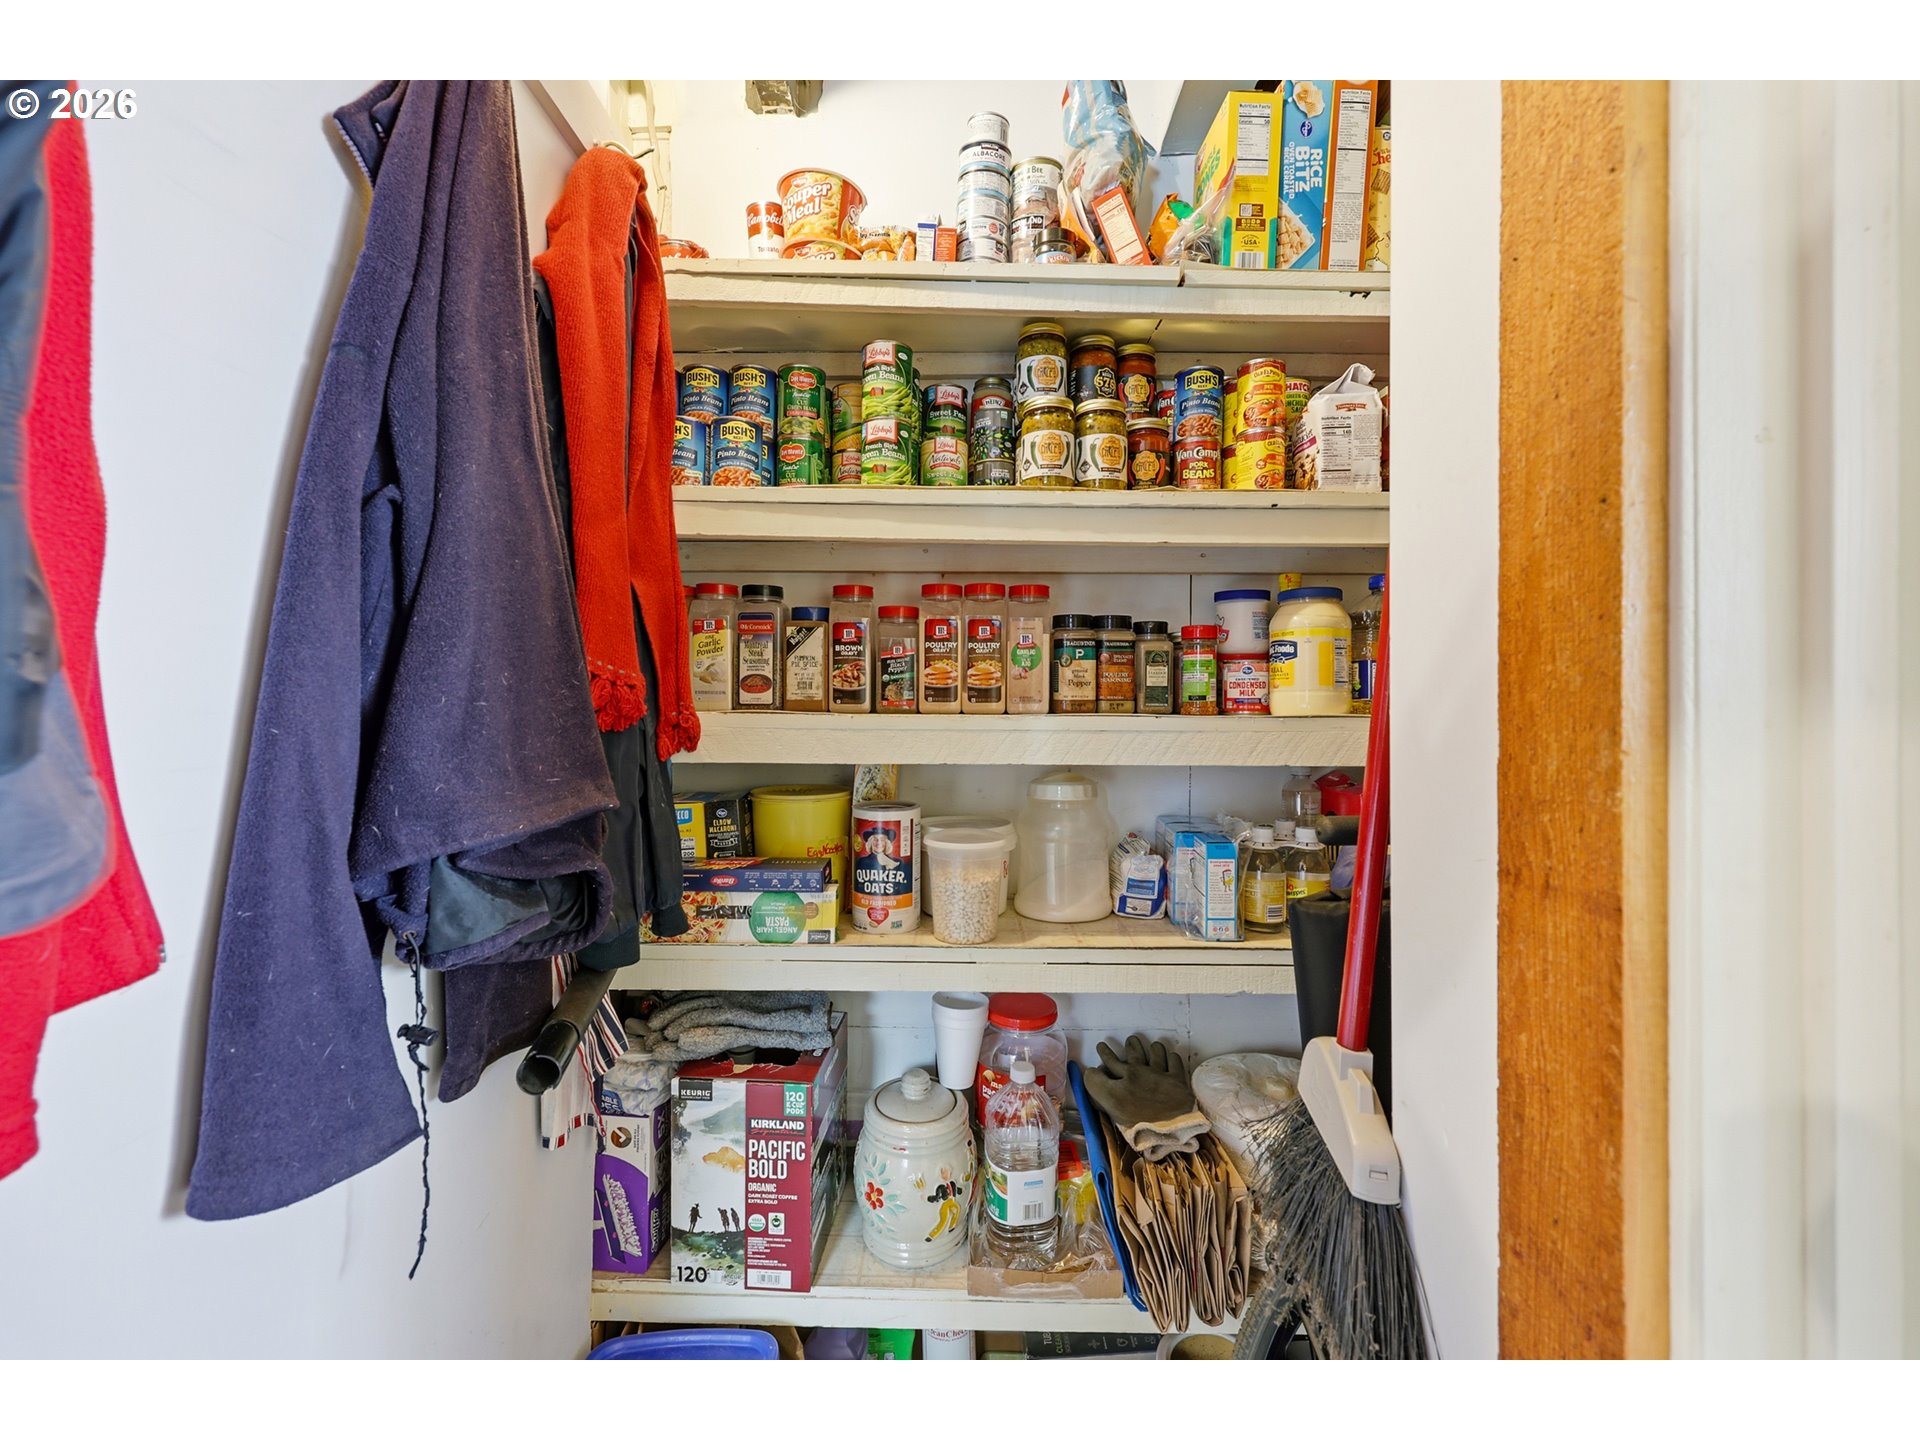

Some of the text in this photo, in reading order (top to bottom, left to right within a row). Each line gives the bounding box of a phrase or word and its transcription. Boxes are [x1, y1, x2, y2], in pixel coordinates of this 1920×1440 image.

[687, 372, 719, 386] BUSH'S
[734, 372, 765, 386] BUSH'S
[879, 370, 905, 384] Beans
[1185, 374, 1219, 388] BUSH'S
[721, 425, 756, 441] BUSH'S
[737, 449, 759, 463] Beans
[881, 448, 906, 461] Beans
[1182, 468, 1215, 480] BEANS
[697, 638, 722, 649] Garlic
[834, 644, 864, 652] BROWN
[925, 641, 958, 649] POULTRY
[1274, 644, 1295, 654] Foods
[696, 645, 724, 657] Powder
[1075, 649, 1085, 660] P
[1067, 679, 1092, 688] Pepper
[1228, 681, 1267, 689] CONDENSED
[1239, 689, 1256, 697] MILK
[712, 818, 732, 826] ELBOW
[709, 825, 737, 834] MACARONI
[863, 882, 895, 895] OATS
[764, 916, 790, 928] PASTA
[774, 926, 799, 935] ANGEL
[680, 1088, 713, 1097] KEURIG
[785, 1091, 805, 1102] 120
[750, 1119, 805, 1131] KIRKLAND
[748, 1138, 806, 1161] PACIFIC
[747, 1159, 788, 1180] BOLD
[747, 1182, 777, 1193] ORGANIC
[676, 1265, 708, 1283] 120
